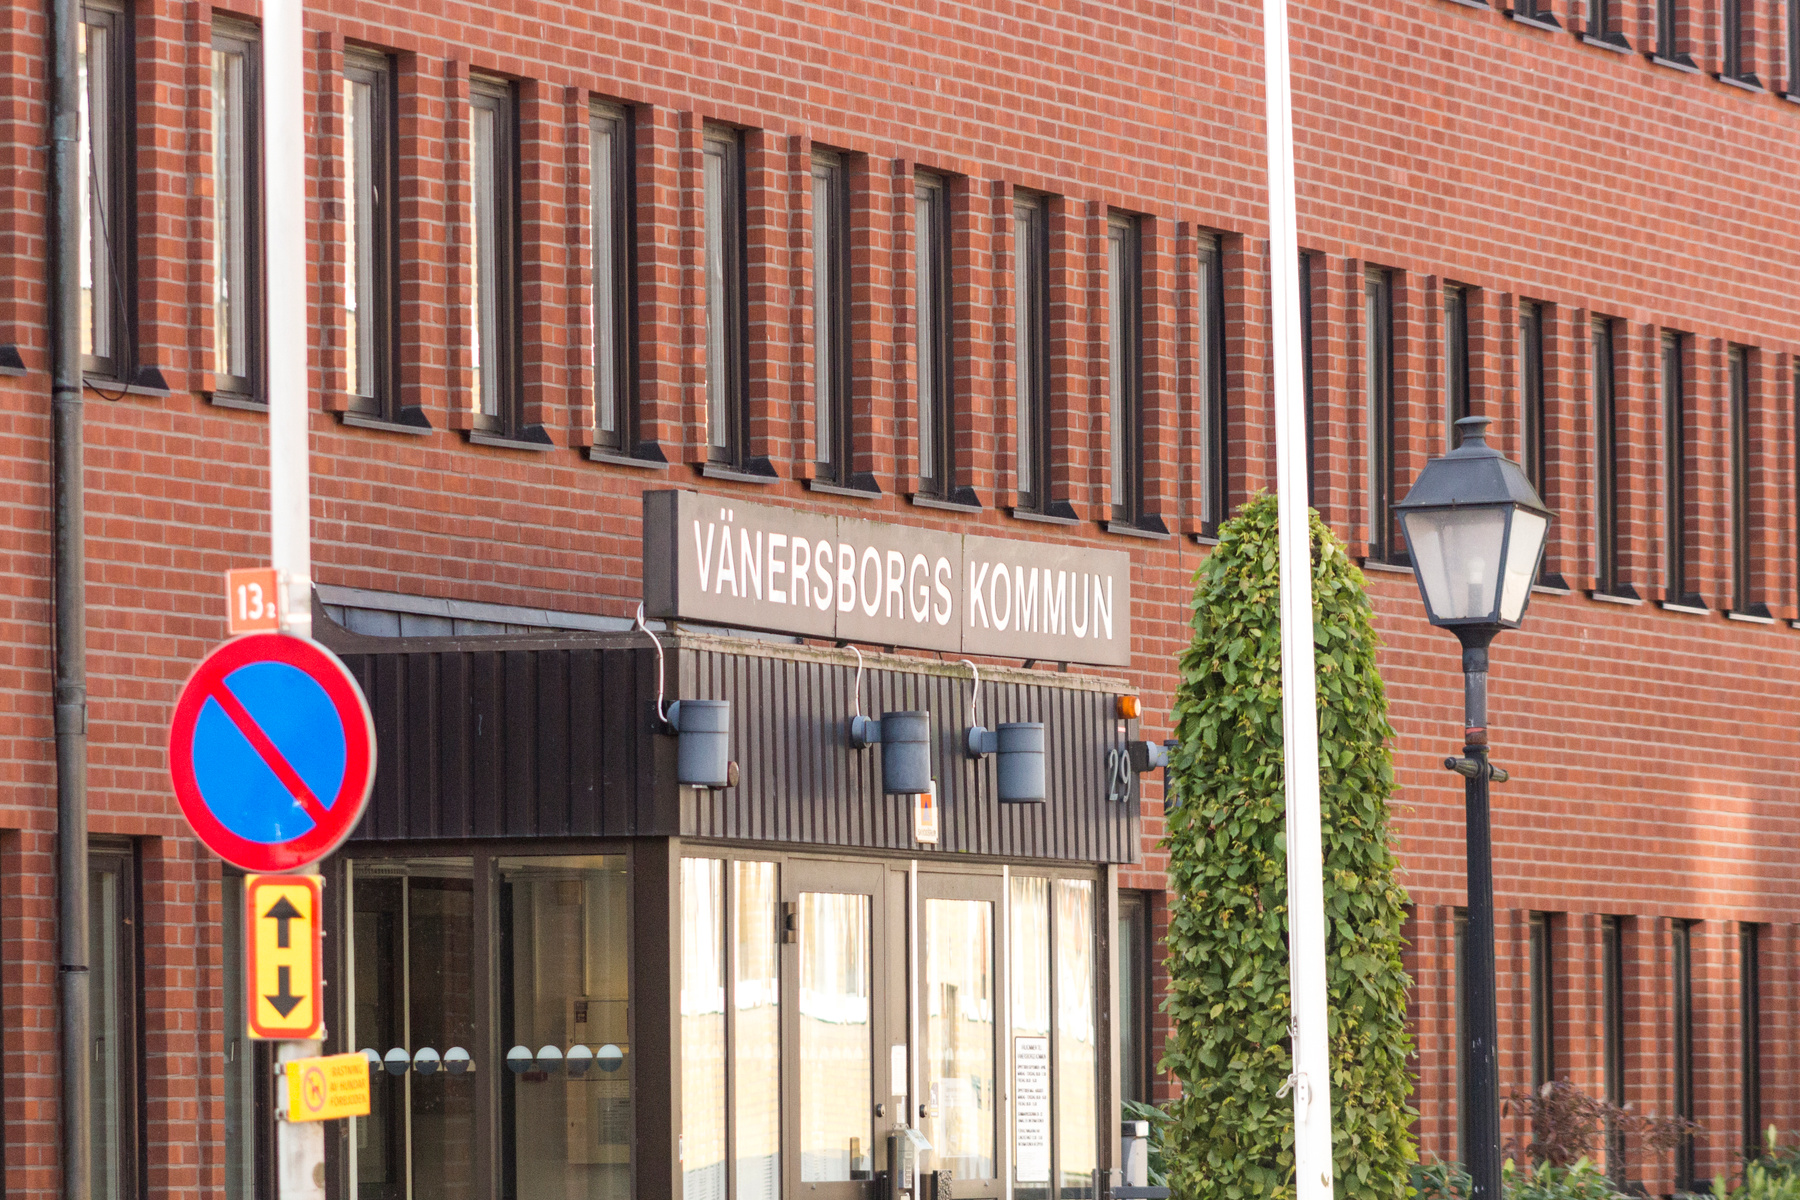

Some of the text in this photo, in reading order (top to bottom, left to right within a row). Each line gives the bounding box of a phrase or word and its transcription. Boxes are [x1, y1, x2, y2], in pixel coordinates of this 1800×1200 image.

[694, 508, 1113, 640] VÄNERSBORGS KOMMUN
[1109, 748, 1132, 803] 29
